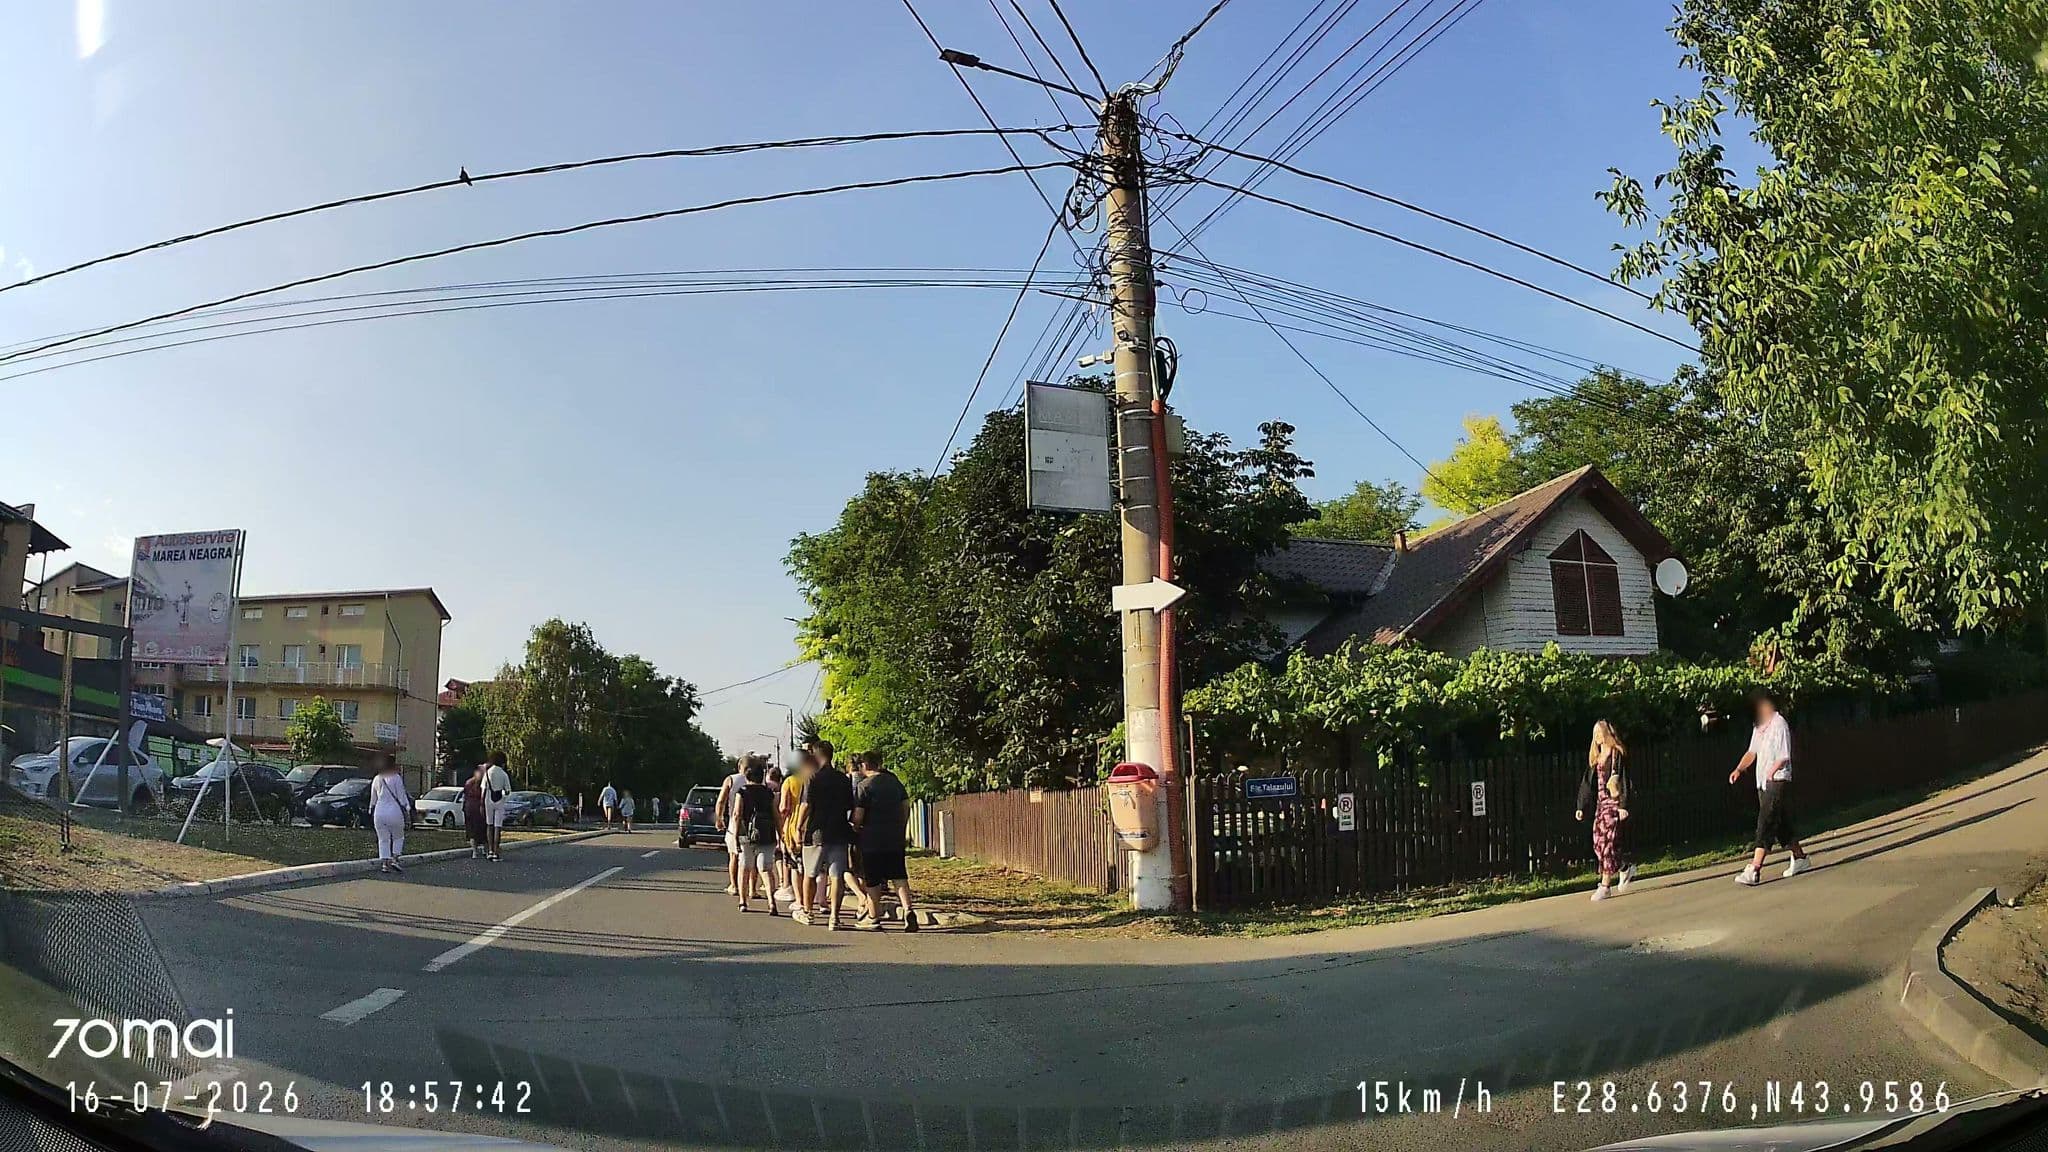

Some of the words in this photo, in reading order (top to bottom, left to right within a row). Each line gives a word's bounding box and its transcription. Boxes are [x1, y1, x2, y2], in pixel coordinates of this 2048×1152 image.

[155, 531, 235, 546] Autoservire
[152, 549, 185, 562] MAREA
[189, 547, 232, 560] NEAGRA
